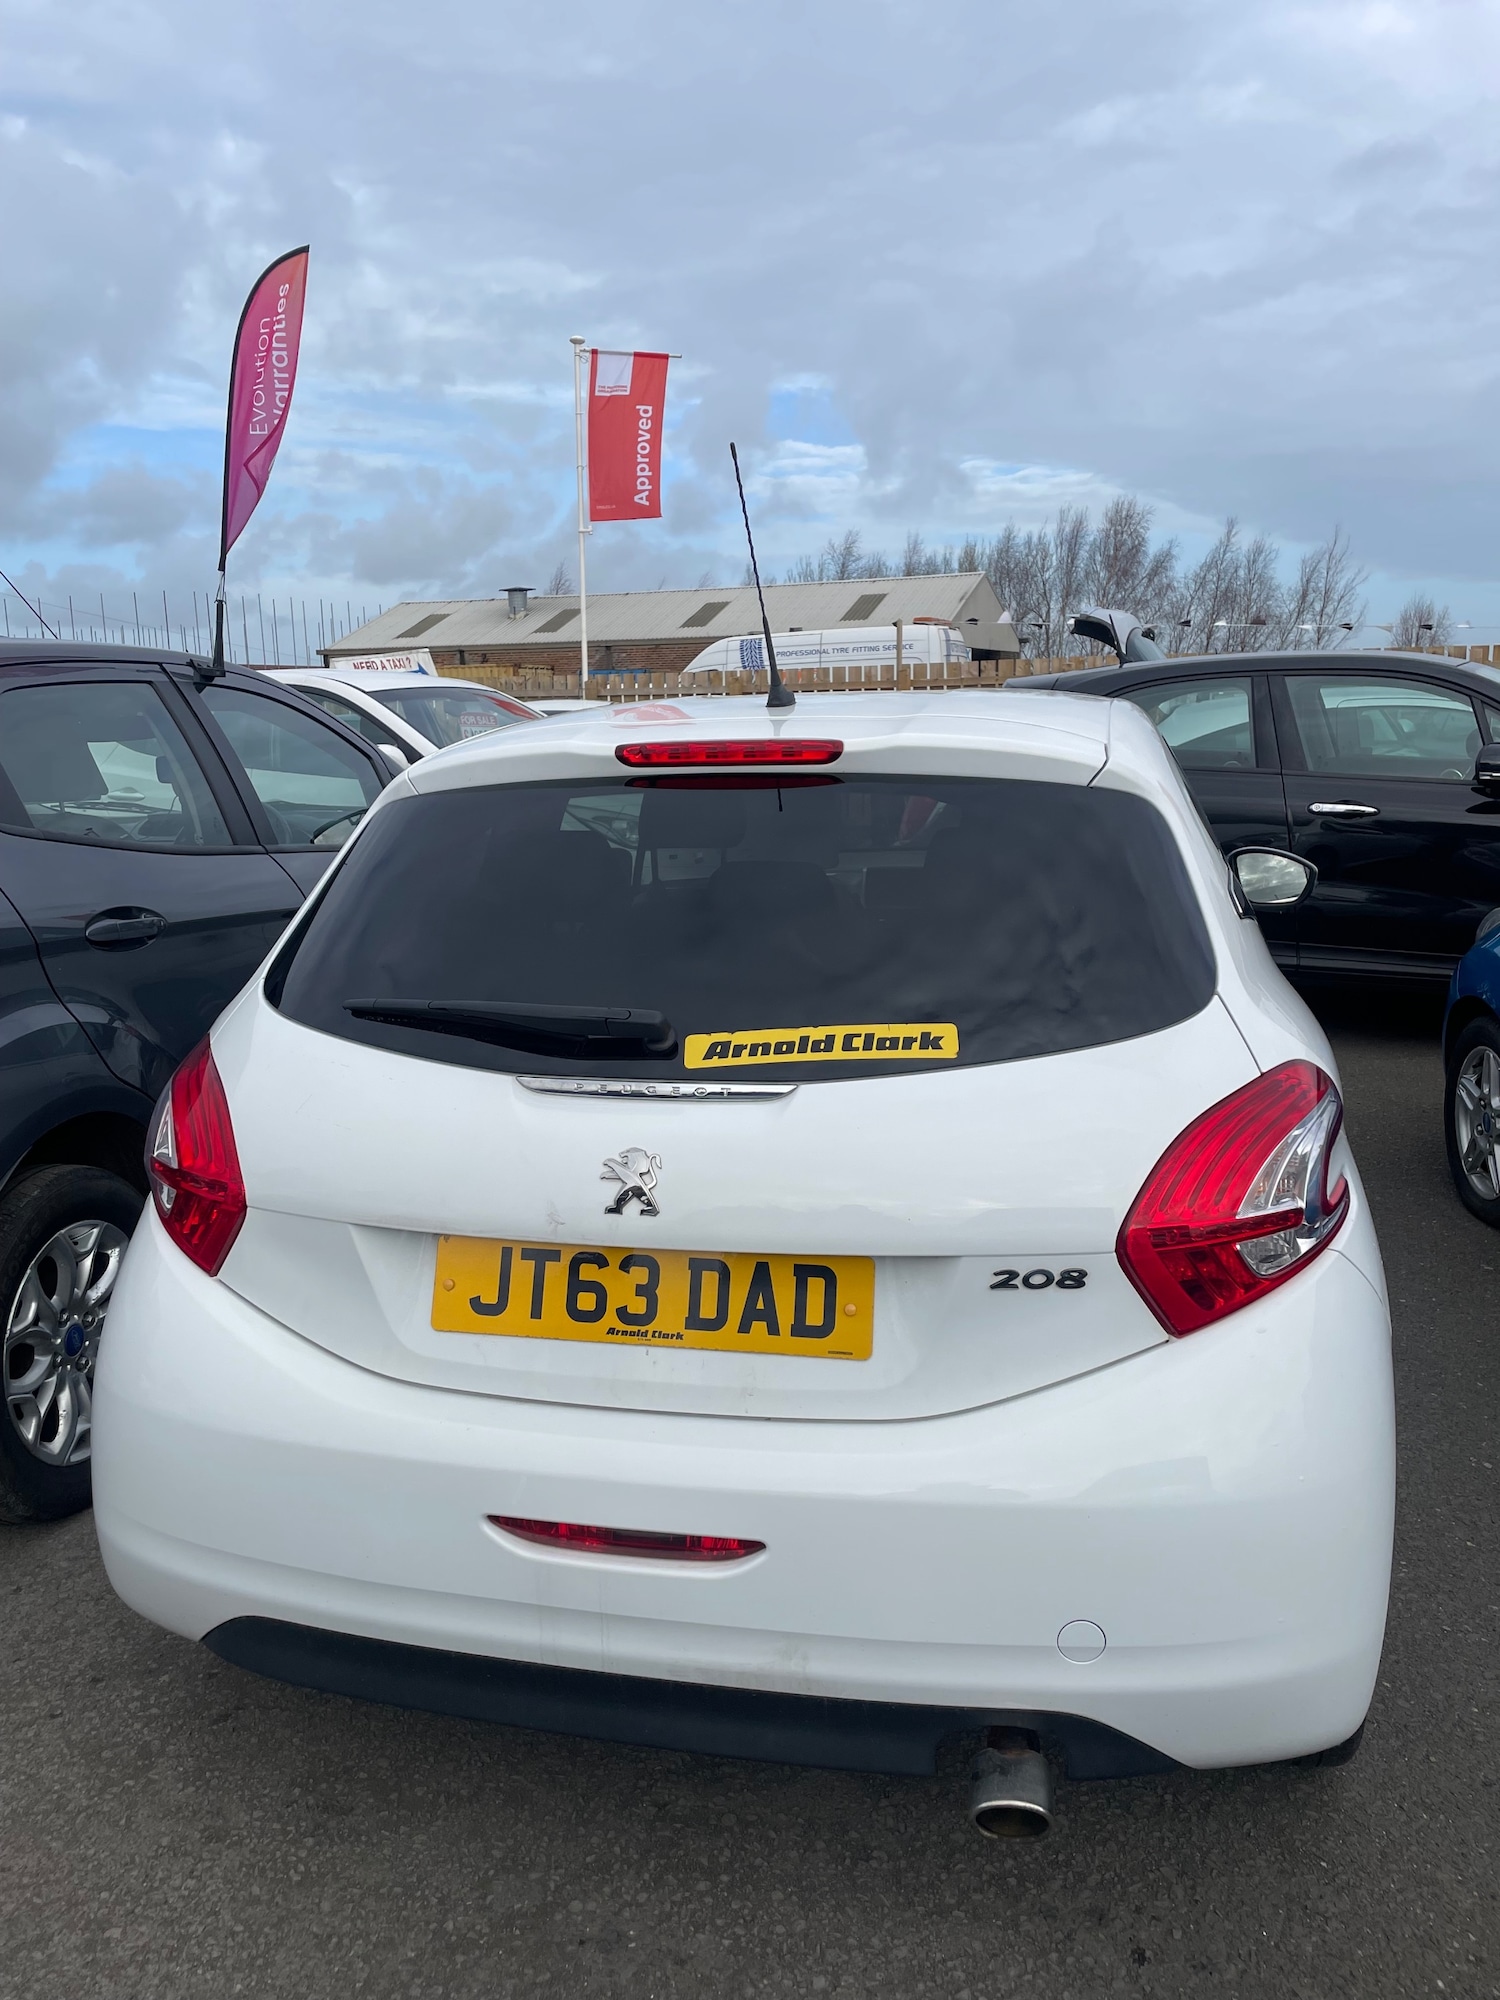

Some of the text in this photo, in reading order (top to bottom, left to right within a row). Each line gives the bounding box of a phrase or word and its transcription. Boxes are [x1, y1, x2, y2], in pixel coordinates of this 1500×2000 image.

[250, 317, 271, 435] Evolution
[634, 405, 653, 506] Approved
[776, 649, 830, 657] PROFESSIONAL
[852, 645, 880, 653] FITTING
[882, 643, 914, 651] SERICE
[380, 660, 388, 670] A
[386, 658, 406, 670] TAXI
[460, 715, 496, 725] FOR SALE
[702, 1032, 945, 1061] Arnold Clark
[573, 1082, 732, 1097] PEUGEOT
[989, 1267, 1088, 1290] 208
[469, 1247, 839, 1340] JT63 DAD
[606, 1327, 649, 1337] Arnold
[651, 1330, 684, 1340] Clark
